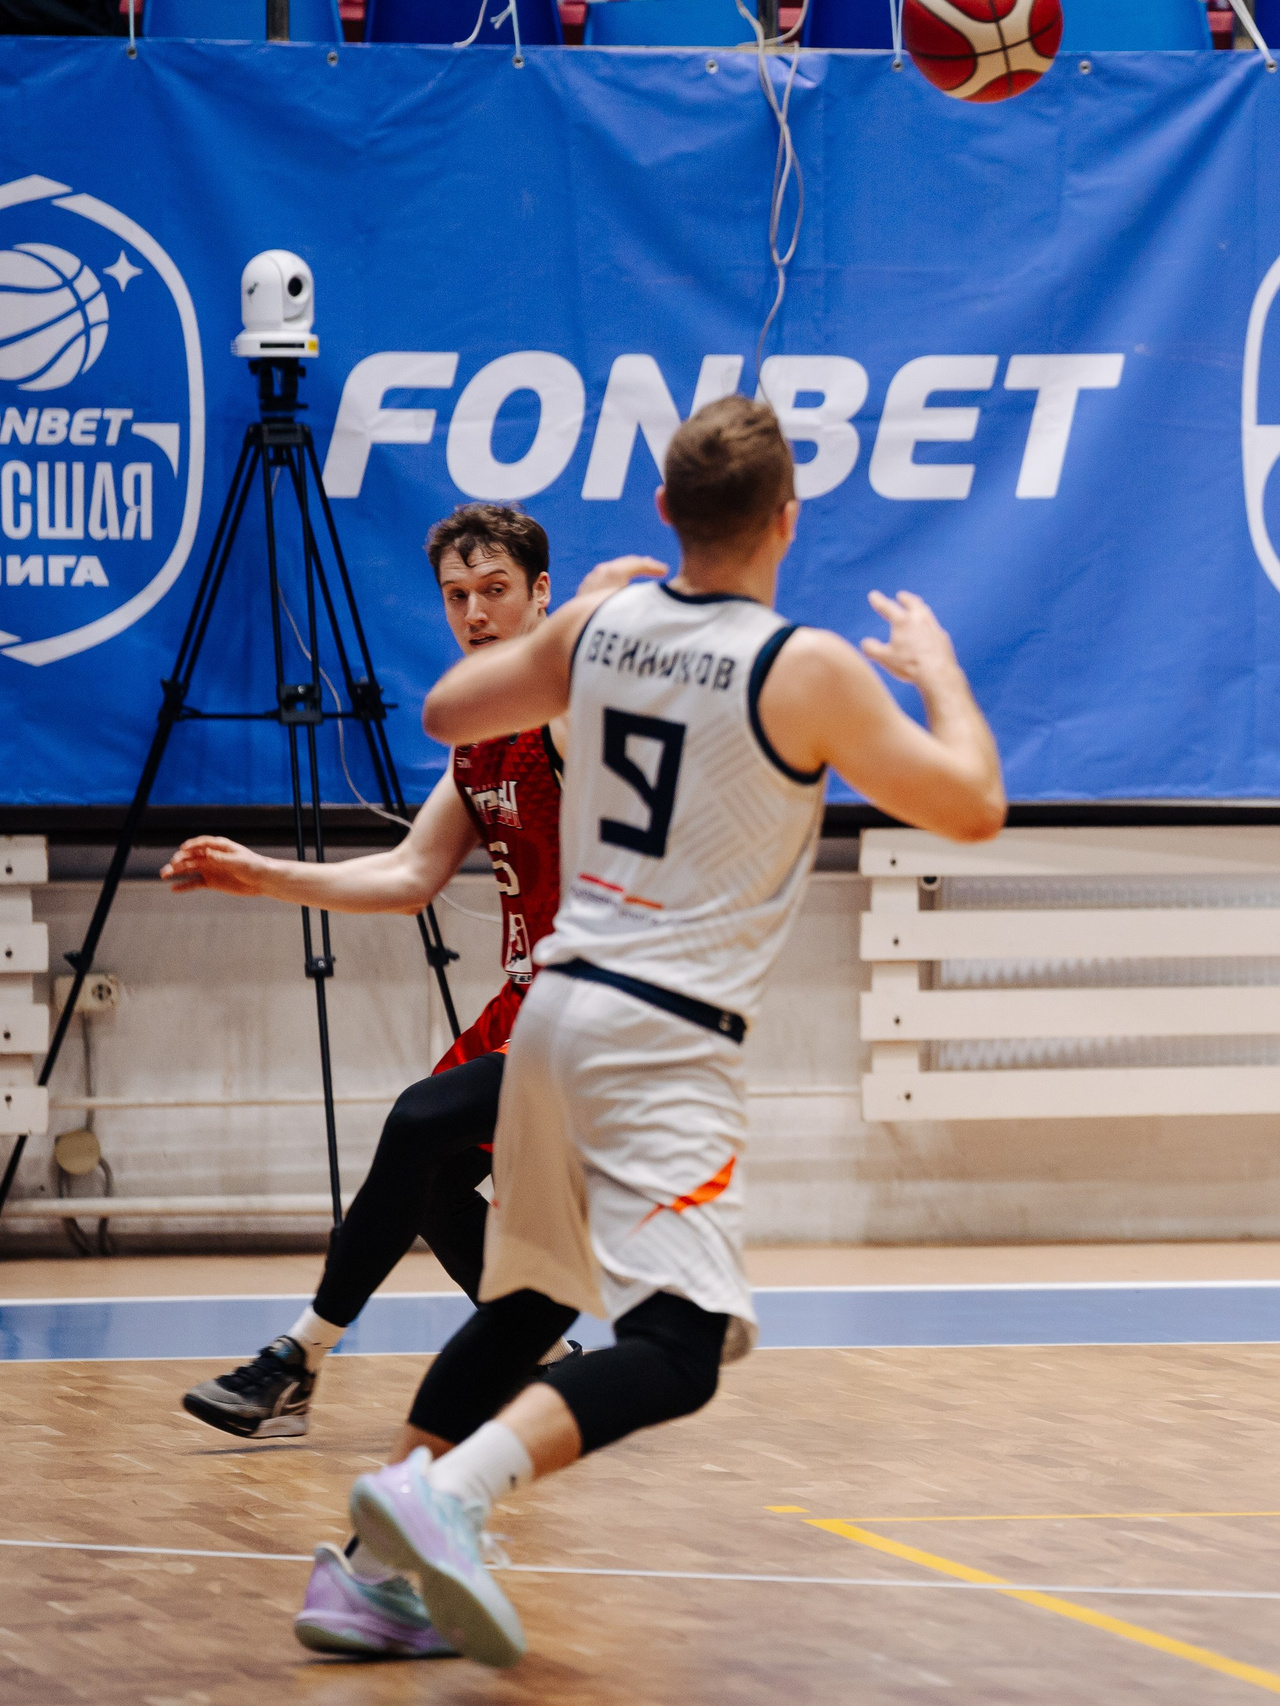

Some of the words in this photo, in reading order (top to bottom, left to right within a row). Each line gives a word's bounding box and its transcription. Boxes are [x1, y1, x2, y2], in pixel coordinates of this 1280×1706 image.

[0, 406, 134, 446] NBET
[322, 351, 1125, 501] FONBET
[0, 459, 153, 541] СШАЯ
[0, 554, 110, 587] ИГА
[599, 706, 687, 860] 9
